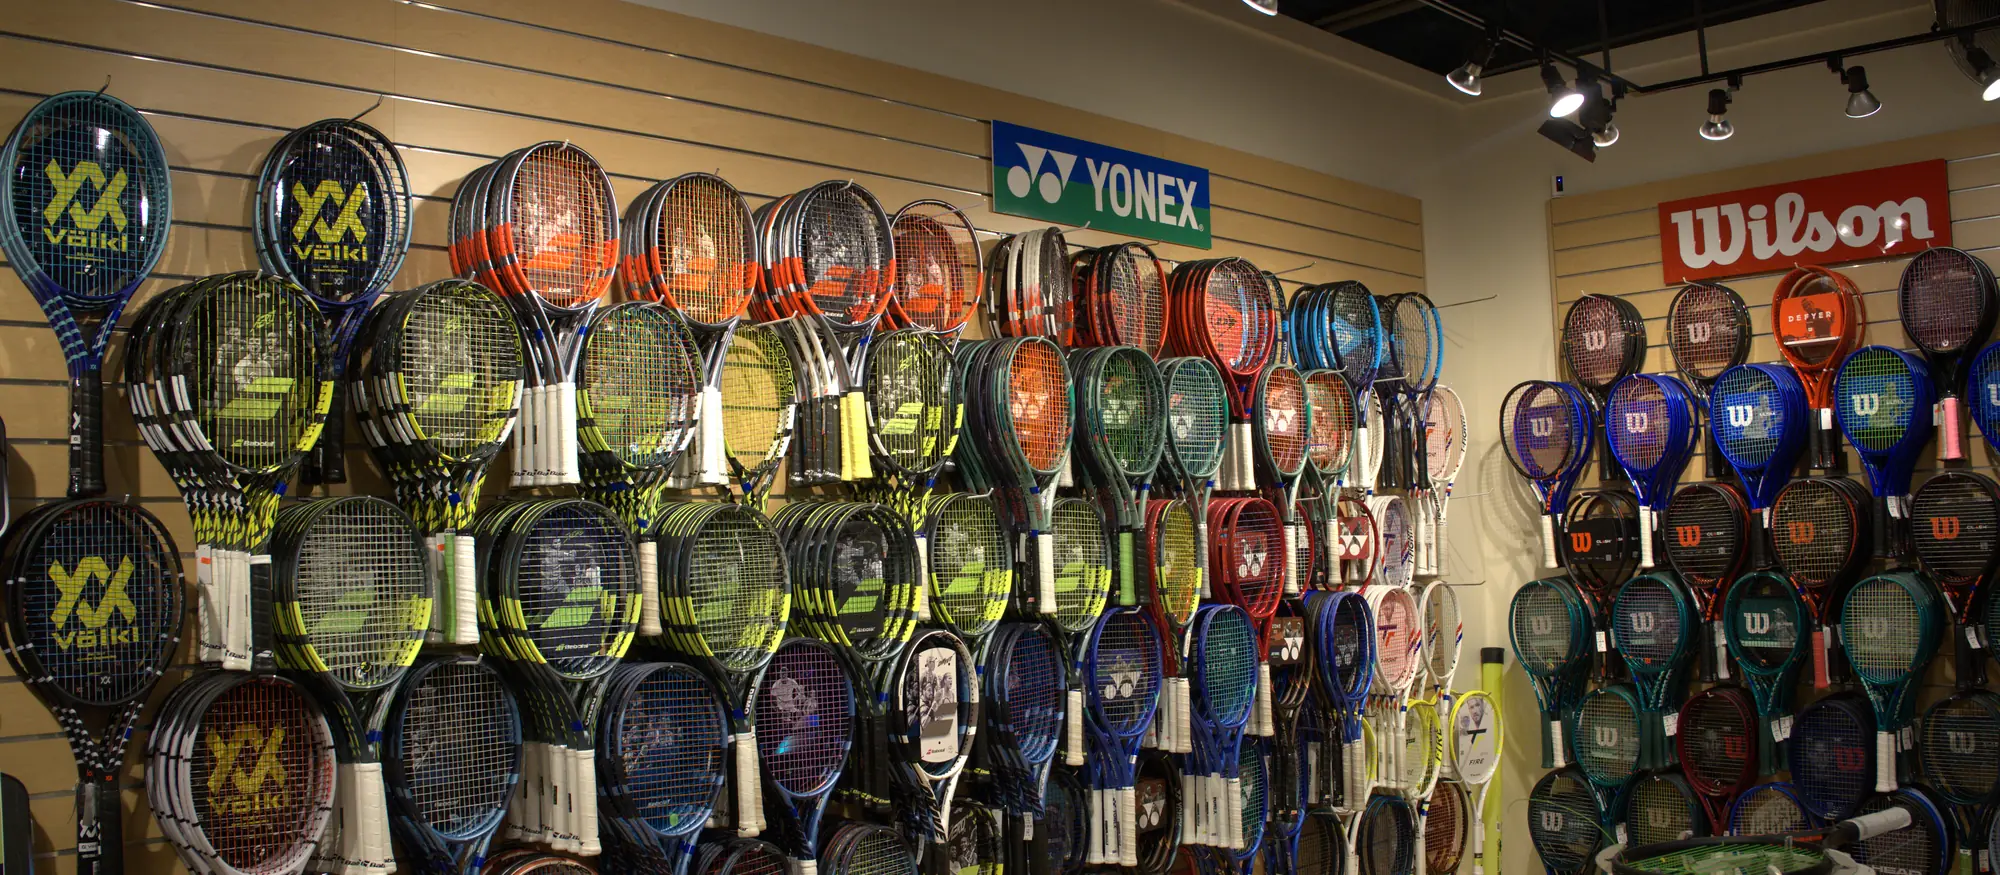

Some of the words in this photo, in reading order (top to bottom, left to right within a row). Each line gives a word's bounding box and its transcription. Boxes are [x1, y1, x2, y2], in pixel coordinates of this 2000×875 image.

[1084, 157, 1199, 230] YONEX
[43, 227, 128, 252] völkl
[1670, 192, 1934, 269] Wilson
[292, 244, 367, 262] völkl
[1788, 311, 1832, 323] DEFYER
[51, 627, 139, 650] völkl
[1469, 758, 1484, 766] FIRE
